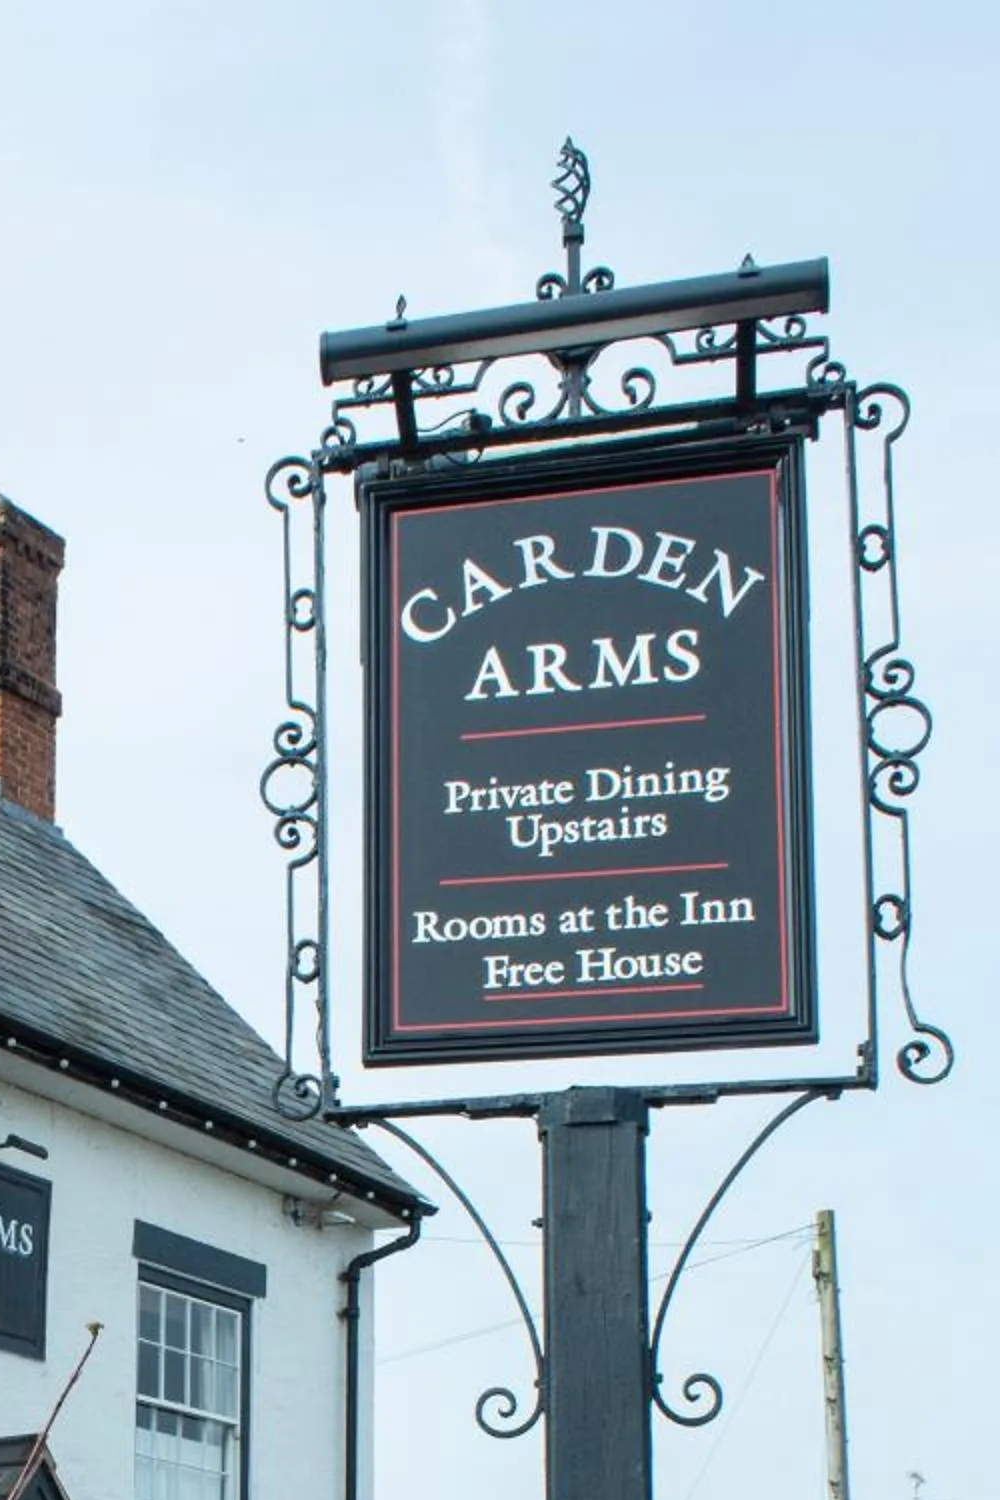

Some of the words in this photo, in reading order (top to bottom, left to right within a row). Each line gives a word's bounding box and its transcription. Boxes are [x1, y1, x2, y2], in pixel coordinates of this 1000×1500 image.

[399, 525, 766, 644] CARDEN
[463, 628, 702, 702] ARMS
[442, 776, 576, 815] Private
[584, 760, 732, 804] Dining
[505, 806, 668, 857] Upstairs
[411, 909, 548, 944] Rooms
[558, 905, 596, 935] at
[604, 894, 670, 932] the
[678, 890, 757, 927] Inn
[482, 953, 566, 990] Free
[574, 946, 705, 984] House
